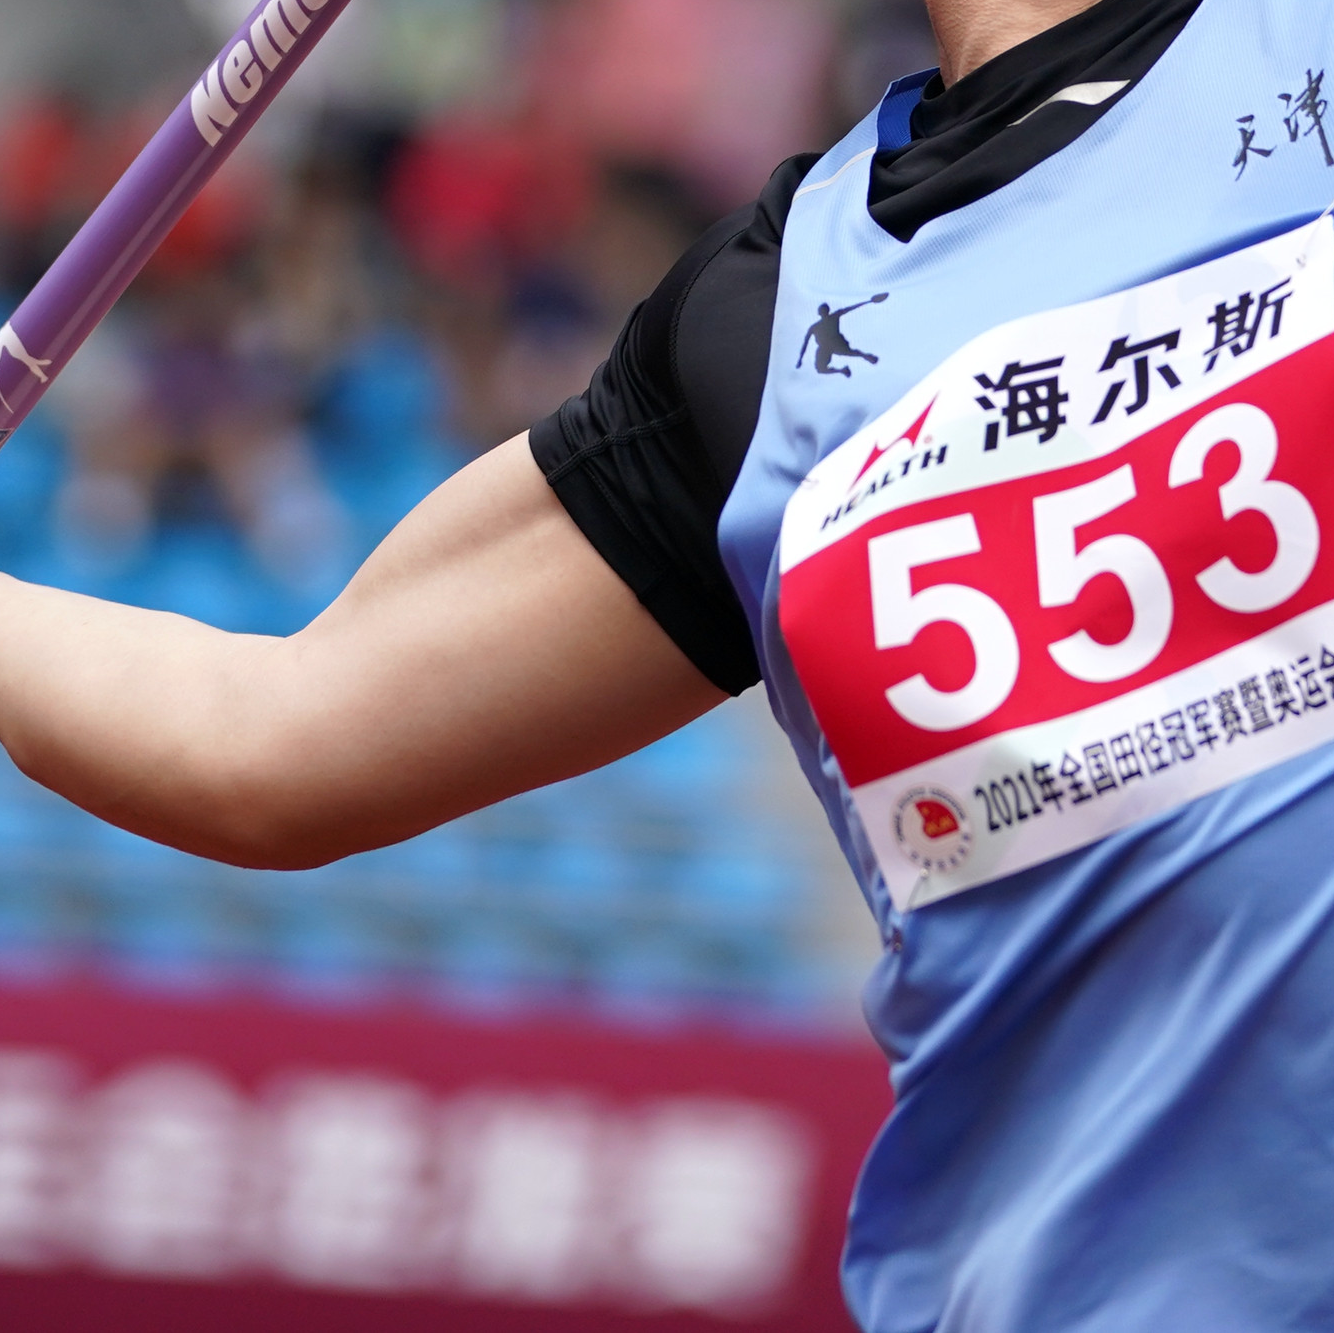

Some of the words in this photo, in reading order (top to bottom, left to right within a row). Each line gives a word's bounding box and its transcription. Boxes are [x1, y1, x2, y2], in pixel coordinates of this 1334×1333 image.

[973, 277, 1294, 452] 海尔斯
[820, 443, 948, 533] HEALTH
[867, 402, 1320, 732] 553
